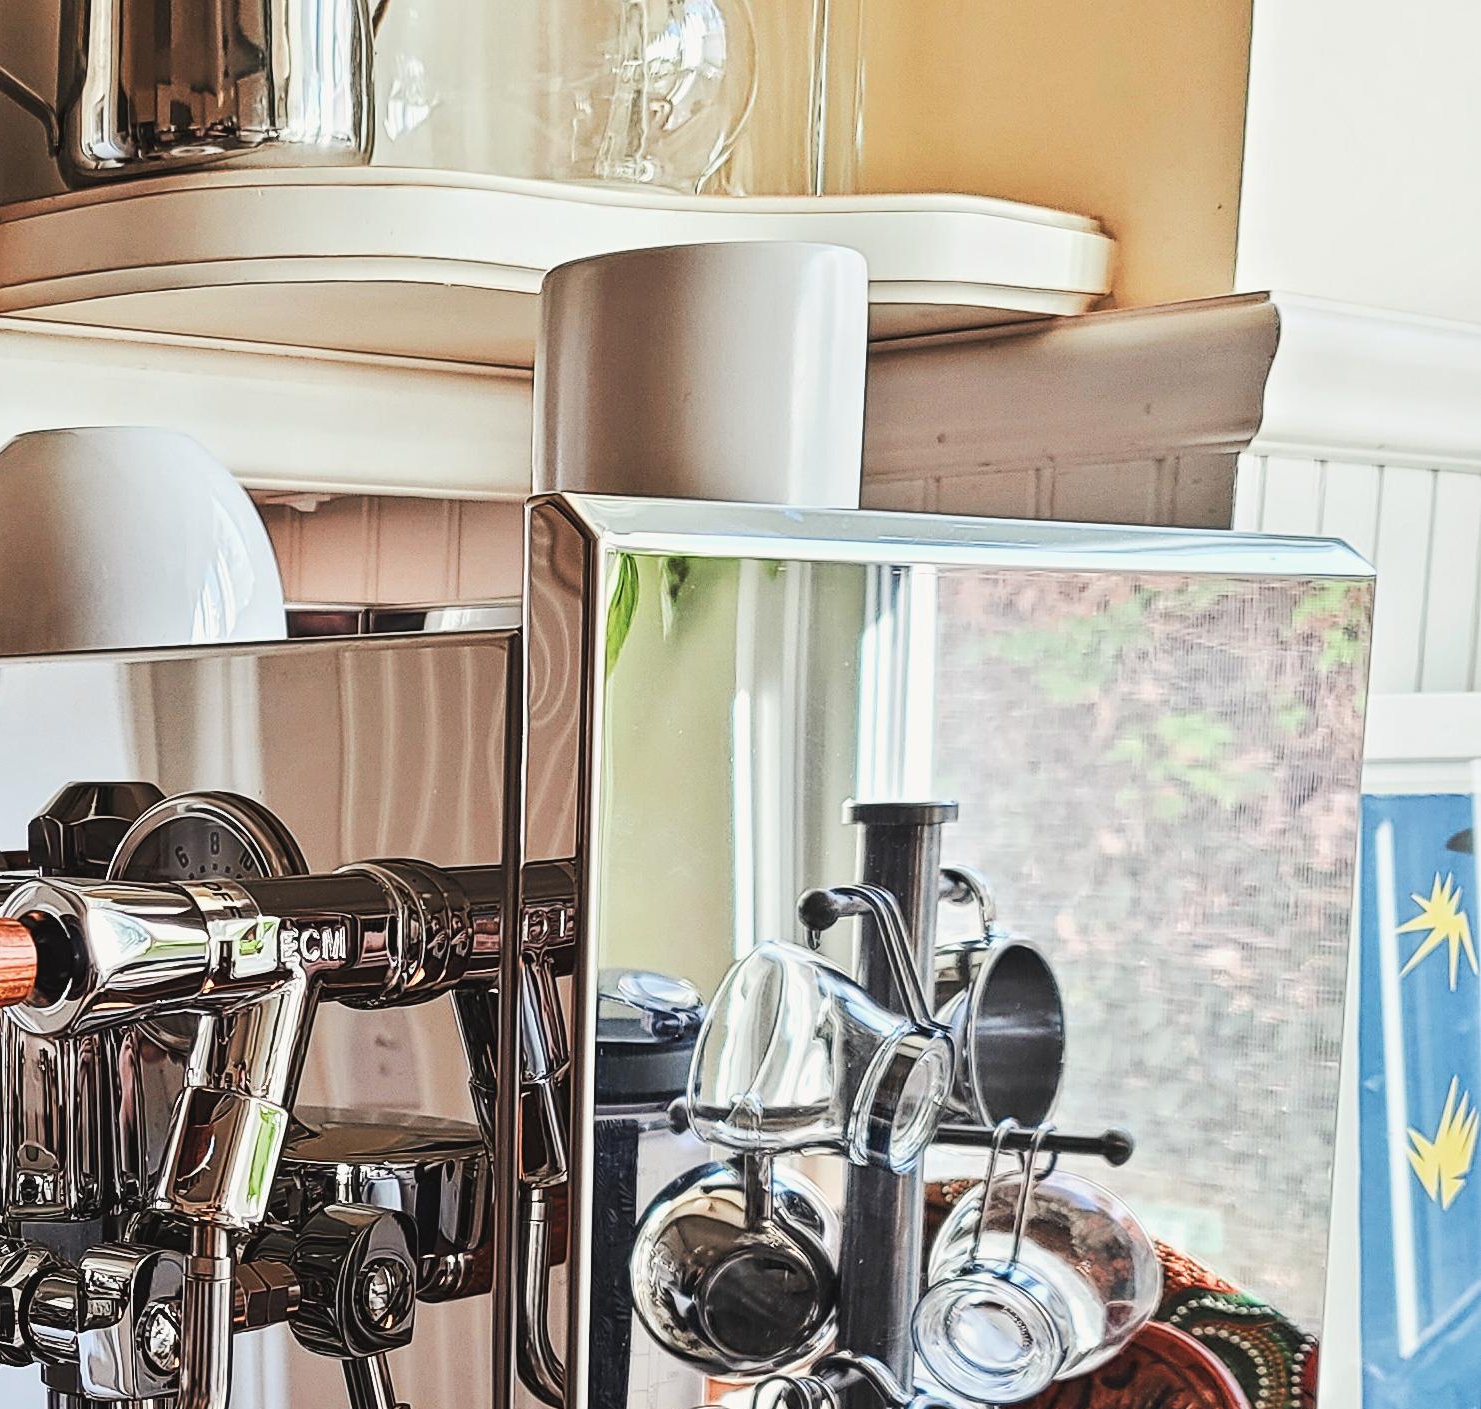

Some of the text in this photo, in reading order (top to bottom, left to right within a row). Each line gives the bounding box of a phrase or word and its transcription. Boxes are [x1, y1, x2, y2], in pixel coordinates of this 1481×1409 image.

[209, 831, 220, 855] 8
[175, 846, 189, 869] 6
[238, 850, 256, 871] 10
[200, 880, 242, 918] OFF
[279, 926, 347, 963] ECM
